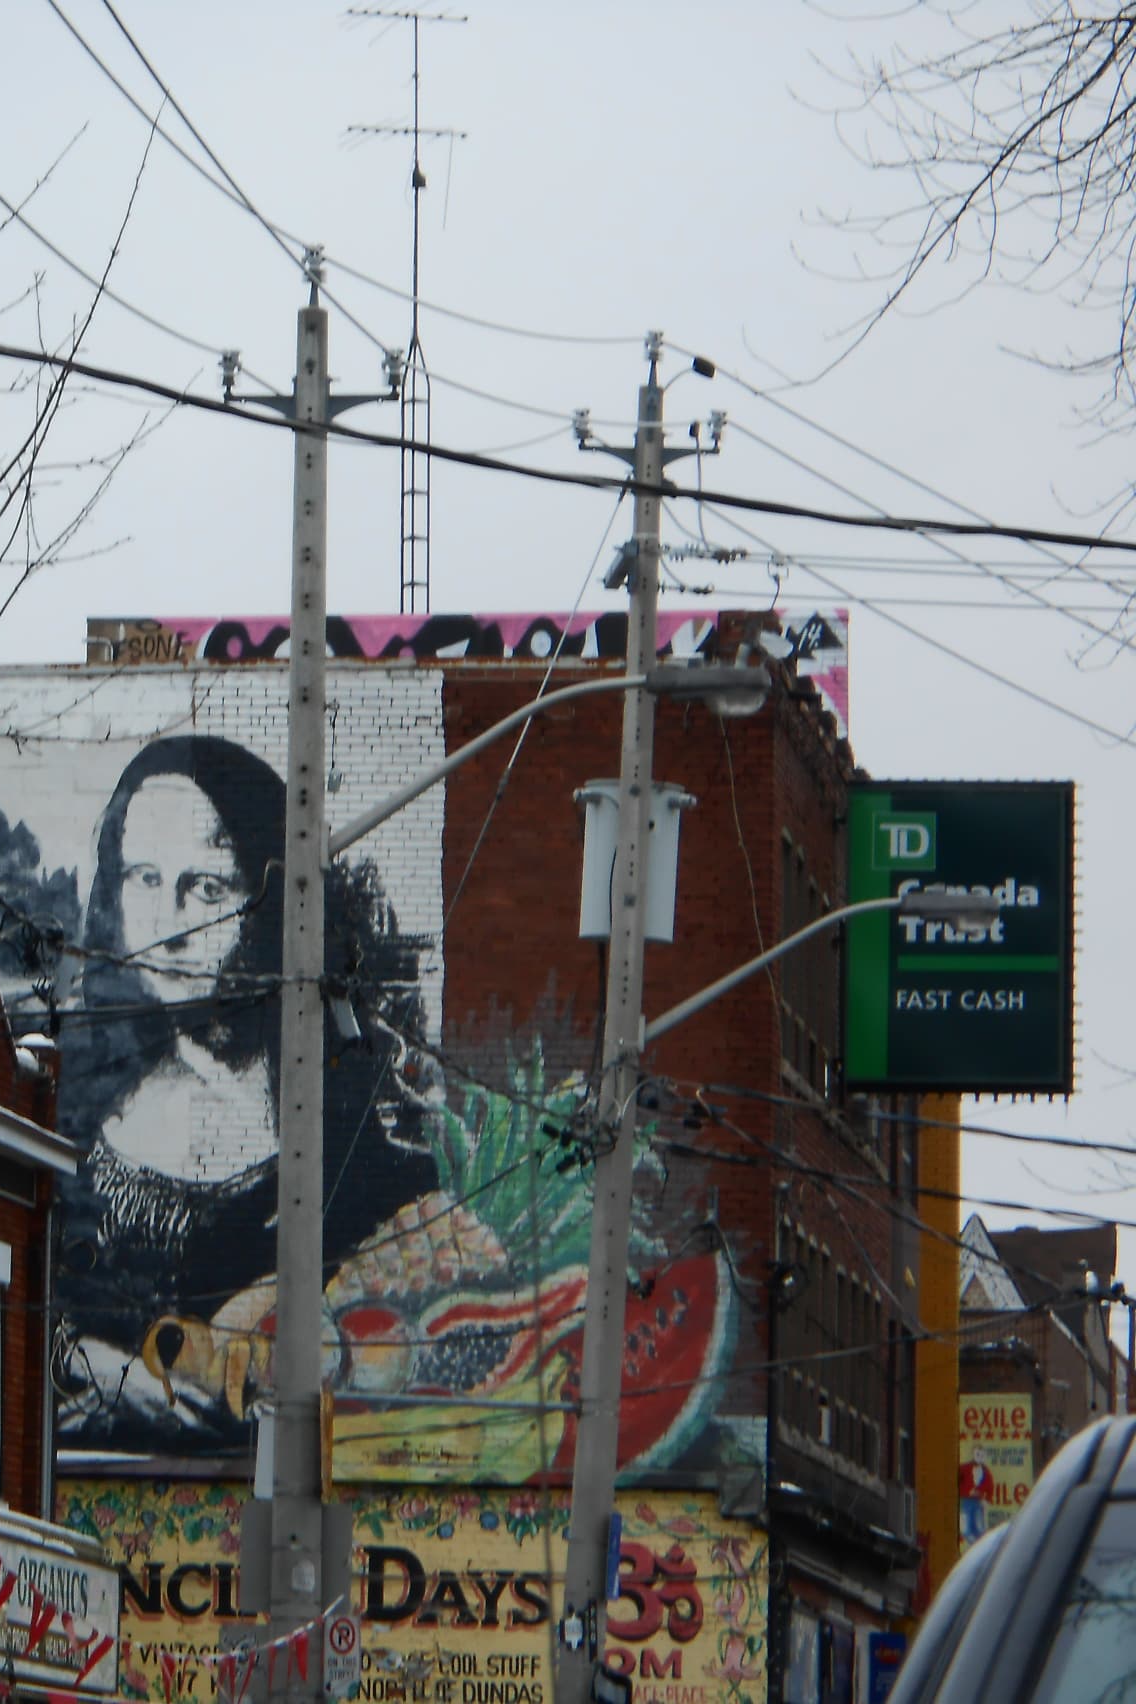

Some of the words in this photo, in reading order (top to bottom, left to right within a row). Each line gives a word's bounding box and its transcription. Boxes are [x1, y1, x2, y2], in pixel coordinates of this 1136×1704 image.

[880, 823, 930, 859] TD
[895, 990, 953, 1010] FAST
[959, 990, 1025, 1010] CASH
[17, 1555, 88, 1620] ORGANICS
[362, 1545, 549, 1626] DAYS
[437, 1651, 484, 1677] COOL
[485, 1654, 542, 1678] STUFF
[605, 1647, 683, 1679] OM
[461, 1680, 544, 1704] DUNDAS
